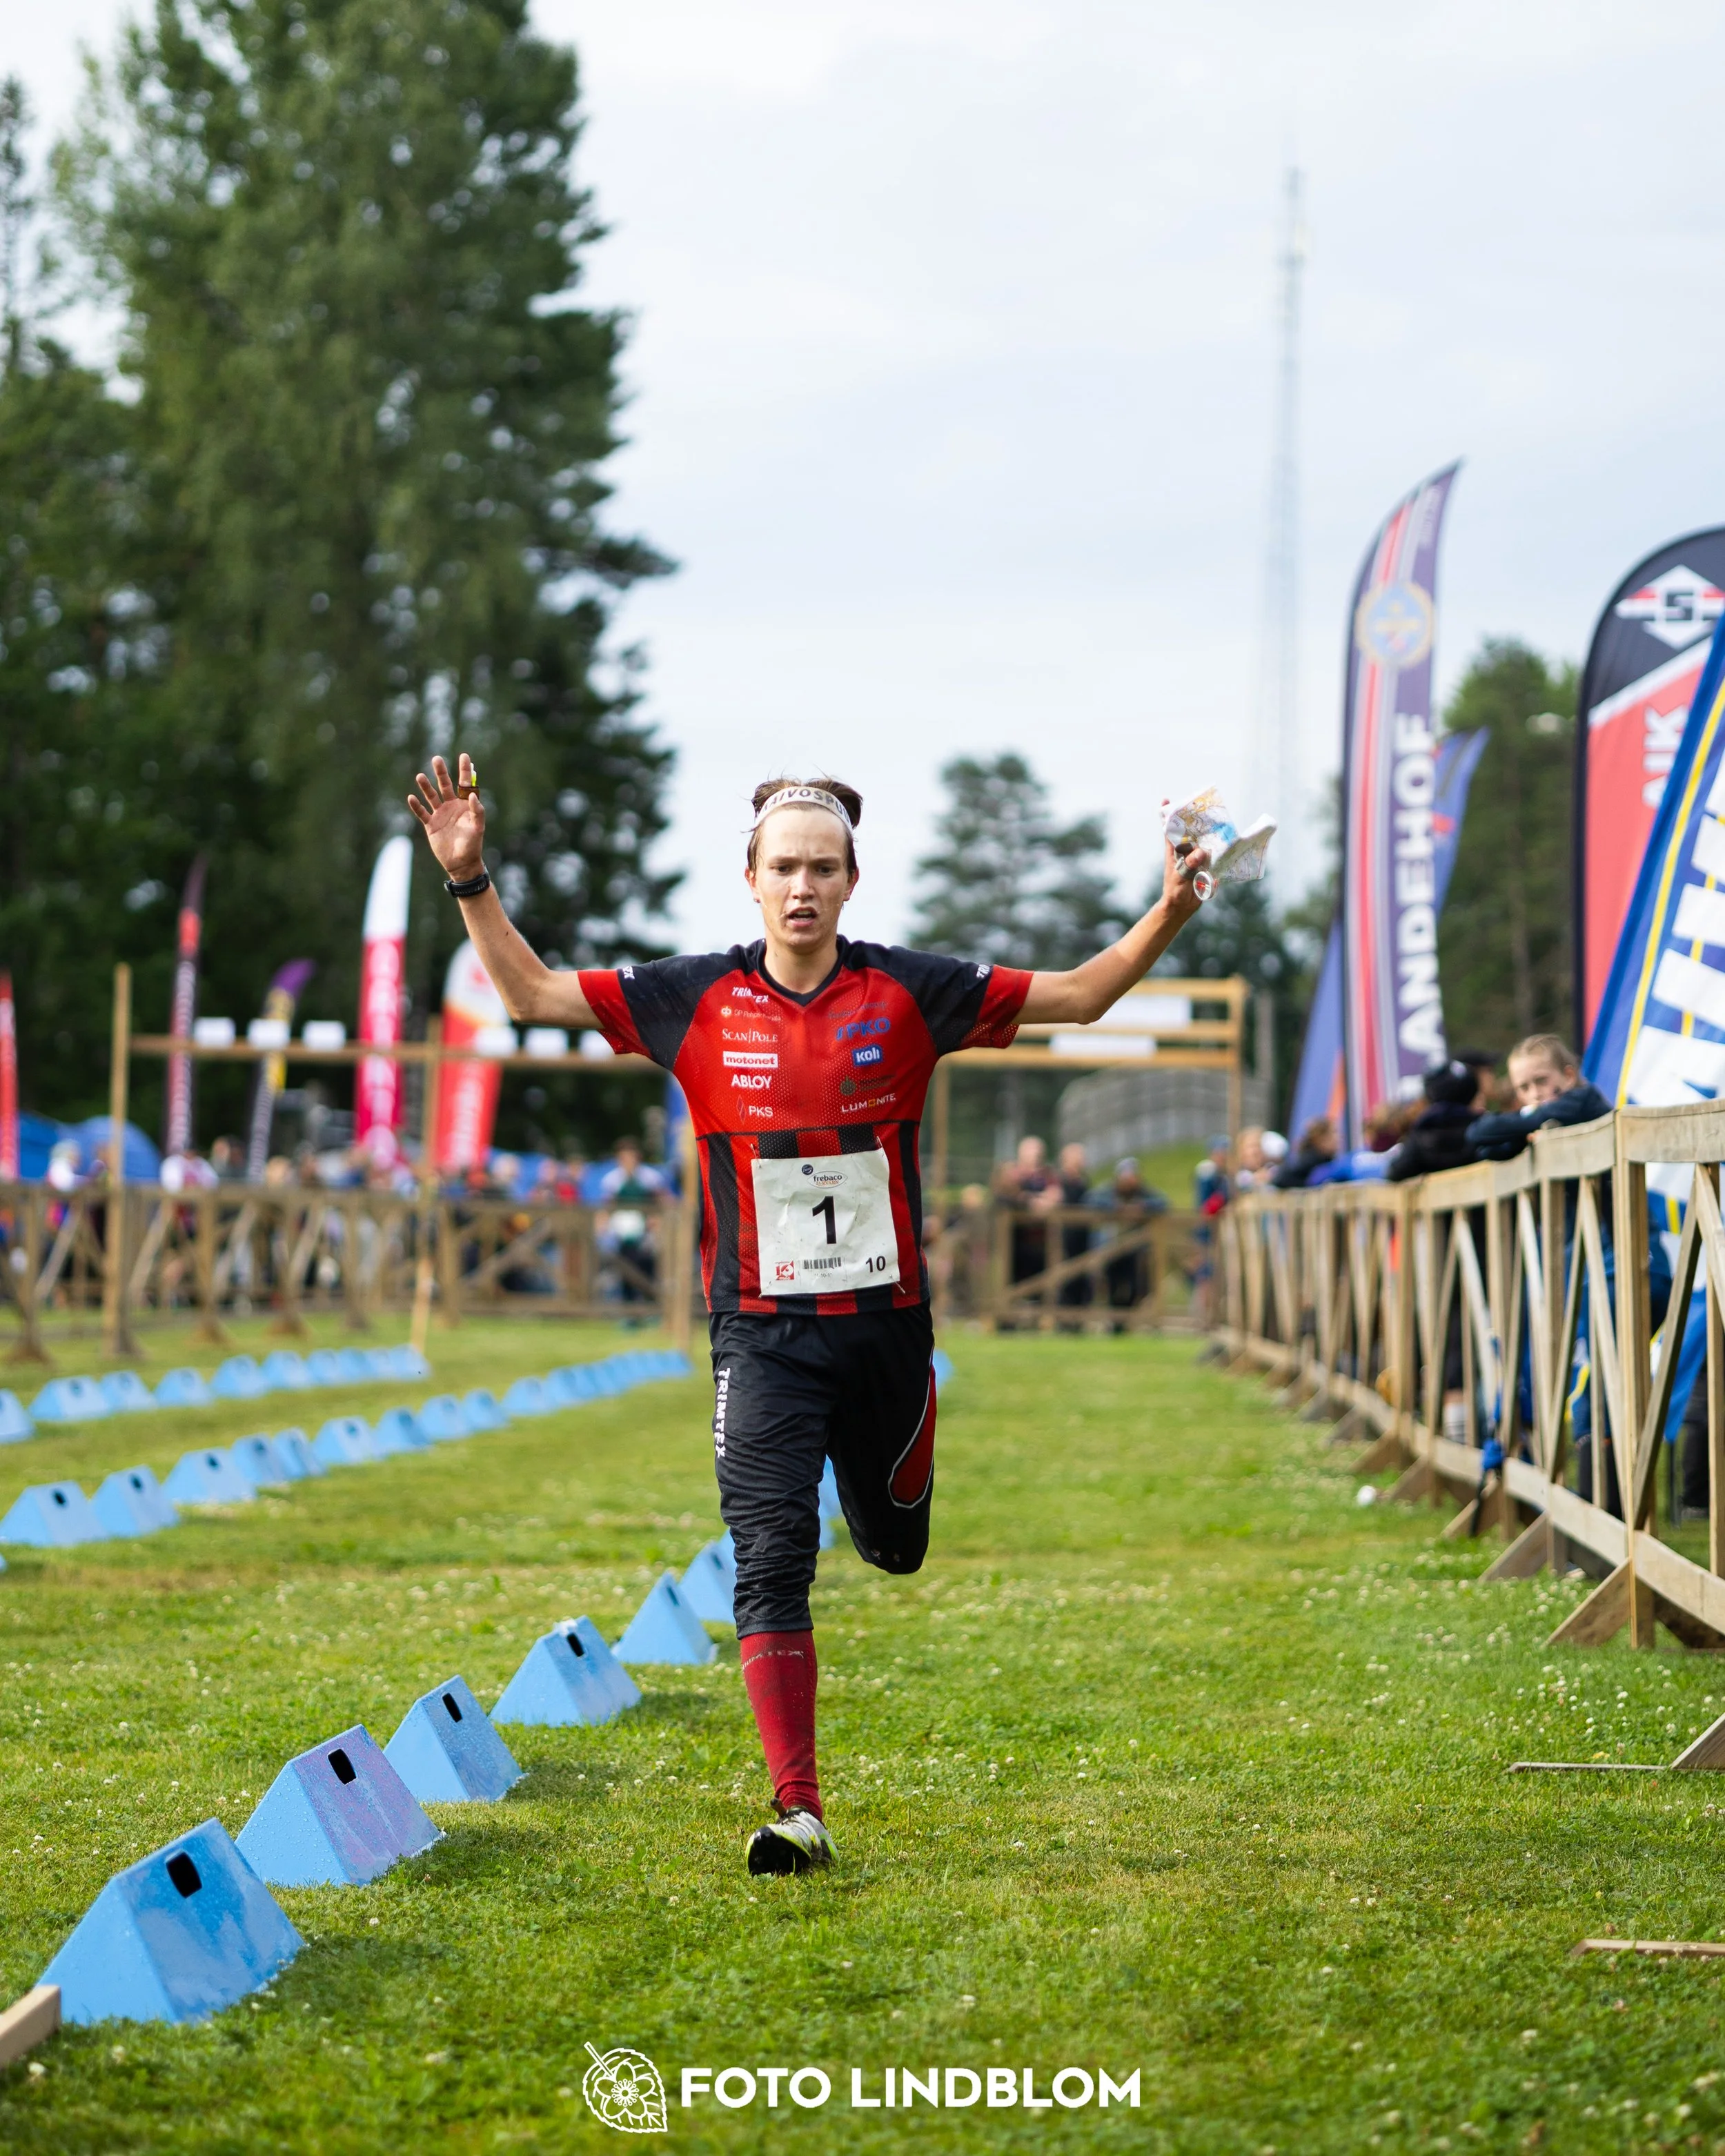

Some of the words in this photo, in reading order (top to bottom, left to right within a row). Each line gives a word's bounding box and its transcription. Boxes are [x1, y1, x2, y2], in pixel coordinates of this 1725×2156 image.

[726, 1056, 775, 1065] motonet
[731, 1074, 772, 1089] ABLOY
[748, 1105, 773, 1117] PKS
[811, 1195, 837, 1245] 1
[865, 1255, 886, 1273] 10
[713, 1367, 731, 1458] TRIMTEX
